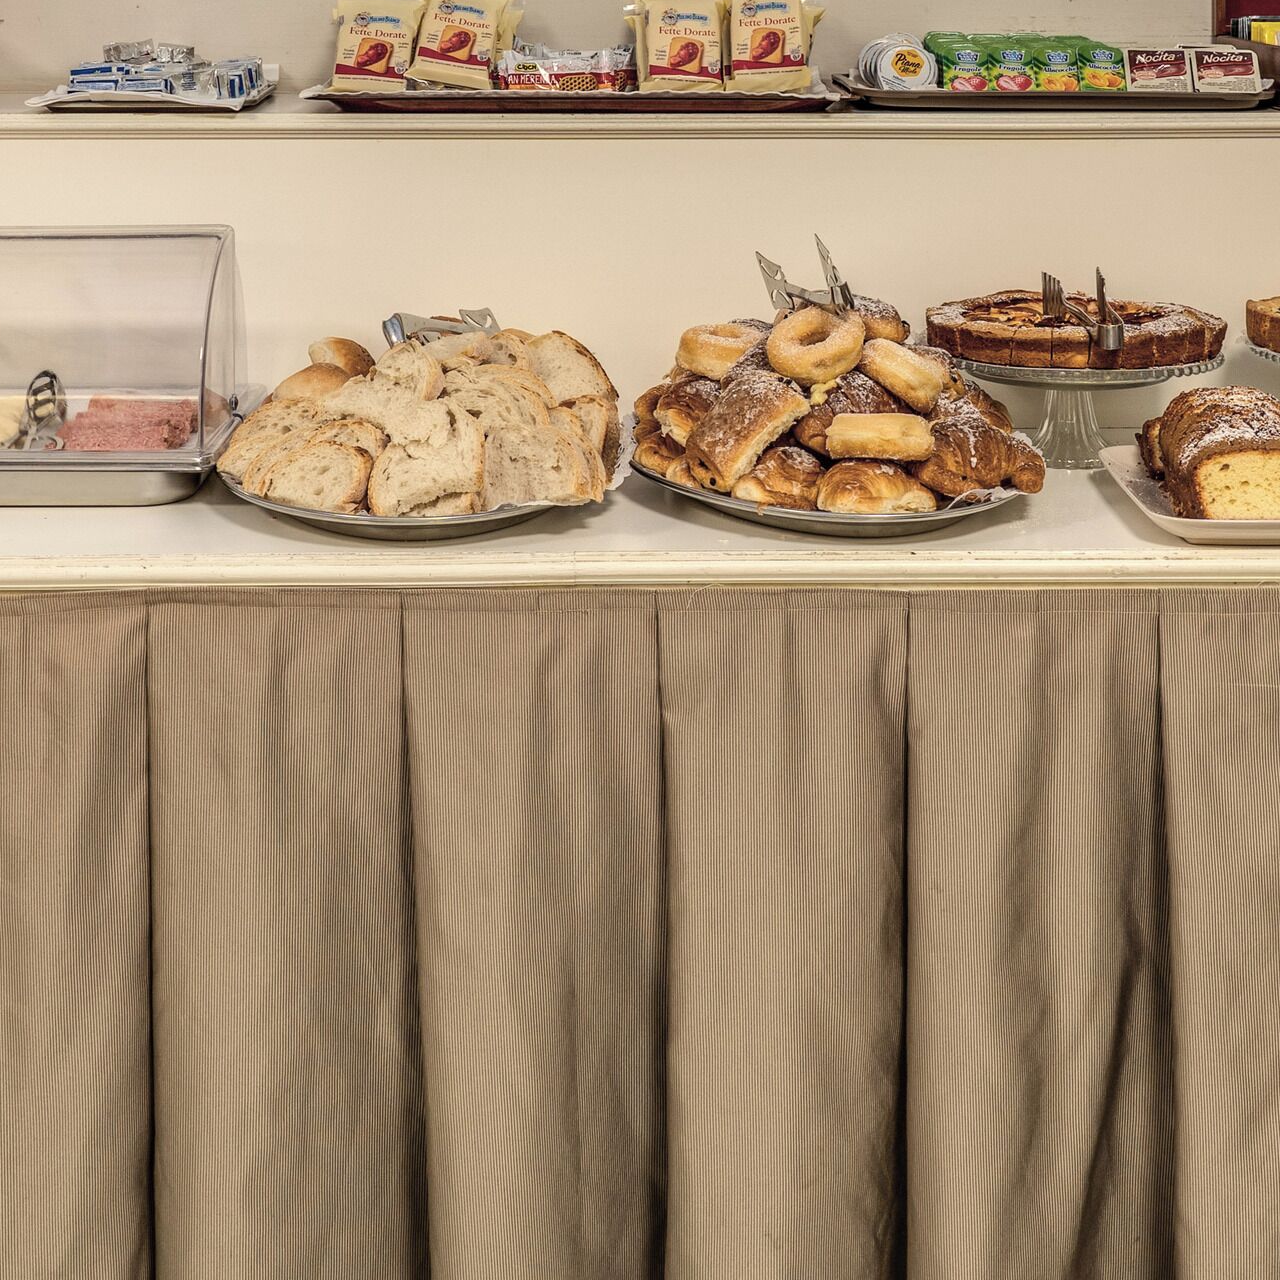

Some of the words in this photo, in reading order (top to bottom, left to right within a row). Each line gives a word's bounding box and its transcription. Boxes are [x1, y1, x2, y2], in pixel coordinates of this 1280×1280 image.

[434, 13, 456, 24] Fette
[459, 18, 491, 29] Dorate
[739, 18, 761, 27] Fette
[764, 16, 796, 25] Dorate
[350, 26, 372, 36] Fette
[375, 29, 407, 39] Dorate
[659, 26, 681, 35] Fette
[684, 28, 716, 37] Dorate
[1135, 52, 1176, 64] Nocita
[1203, 52, 1243, 64] Nocita
[999, 64, 1027, 72] Fragole
[520, 74, 556, 85] MERENA
